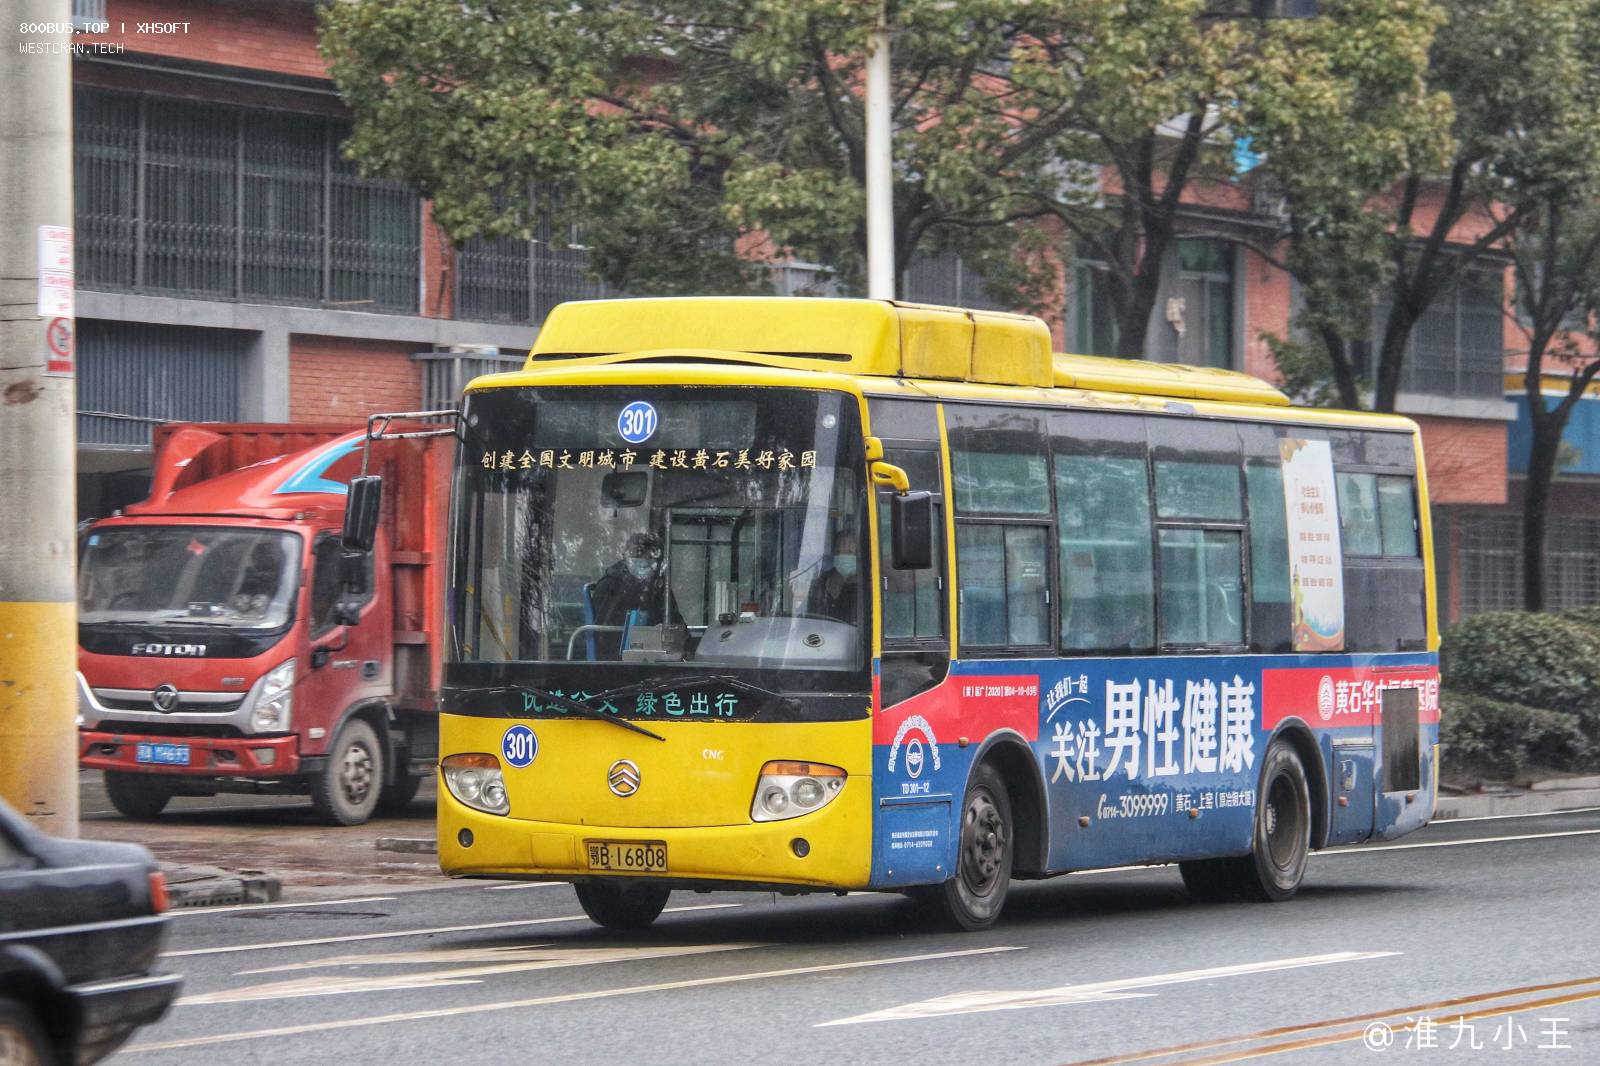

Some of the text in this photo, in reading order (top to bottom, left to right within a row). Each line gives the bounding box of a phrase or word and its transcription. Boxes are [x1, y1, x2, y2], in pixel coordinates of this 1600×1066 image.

[622, 407, 653, 436] 301
[480, 449, 818, 471] 创建全国文明城市 建设黄石美好家园
[131, 643, 207, 656] FOTON
[635, 691, 739, 716] 绿色出行
[1046, 673, 1089, 711] 让我们一起
[1051, 674, 1256, 784] 关注 男性健康
[506, 732, 534, 761] 301
